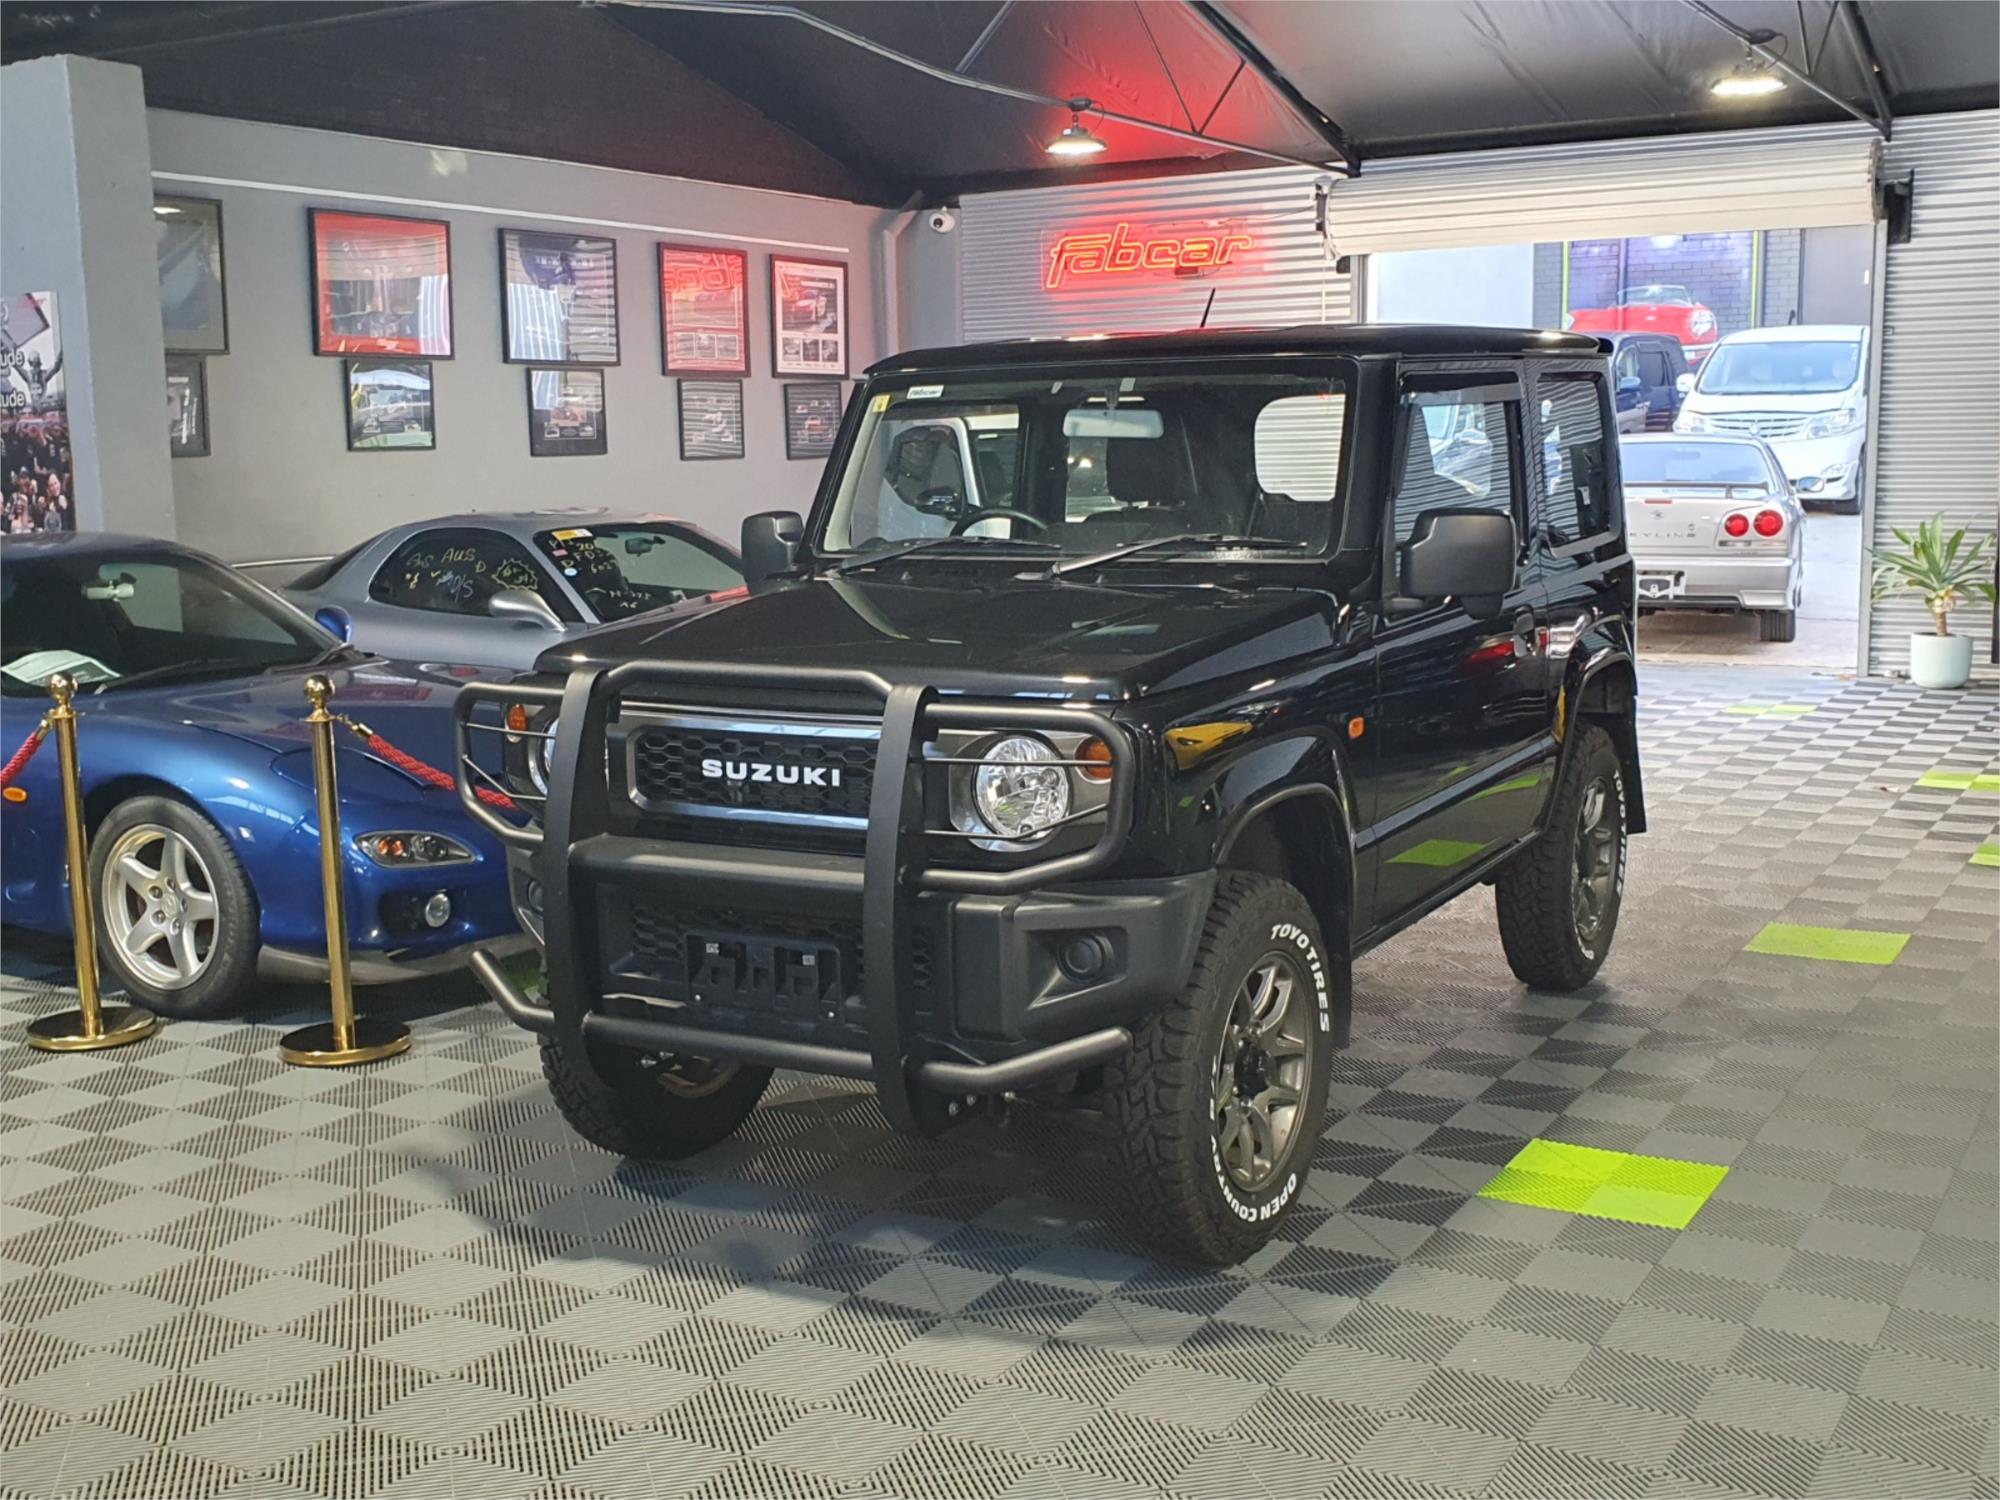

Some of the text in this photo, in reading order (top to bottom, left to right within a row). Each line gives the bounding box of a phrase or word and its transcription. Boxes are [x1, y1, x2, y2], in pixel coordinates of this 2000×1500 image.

[1047, 223, 1252, 288] fabcar
[702, 759, 840, 787] SUZUKI
[1271, 923, 1330, 1033] TOYO TIRES
[1260, 1172, 1298, 1221] OPEN
